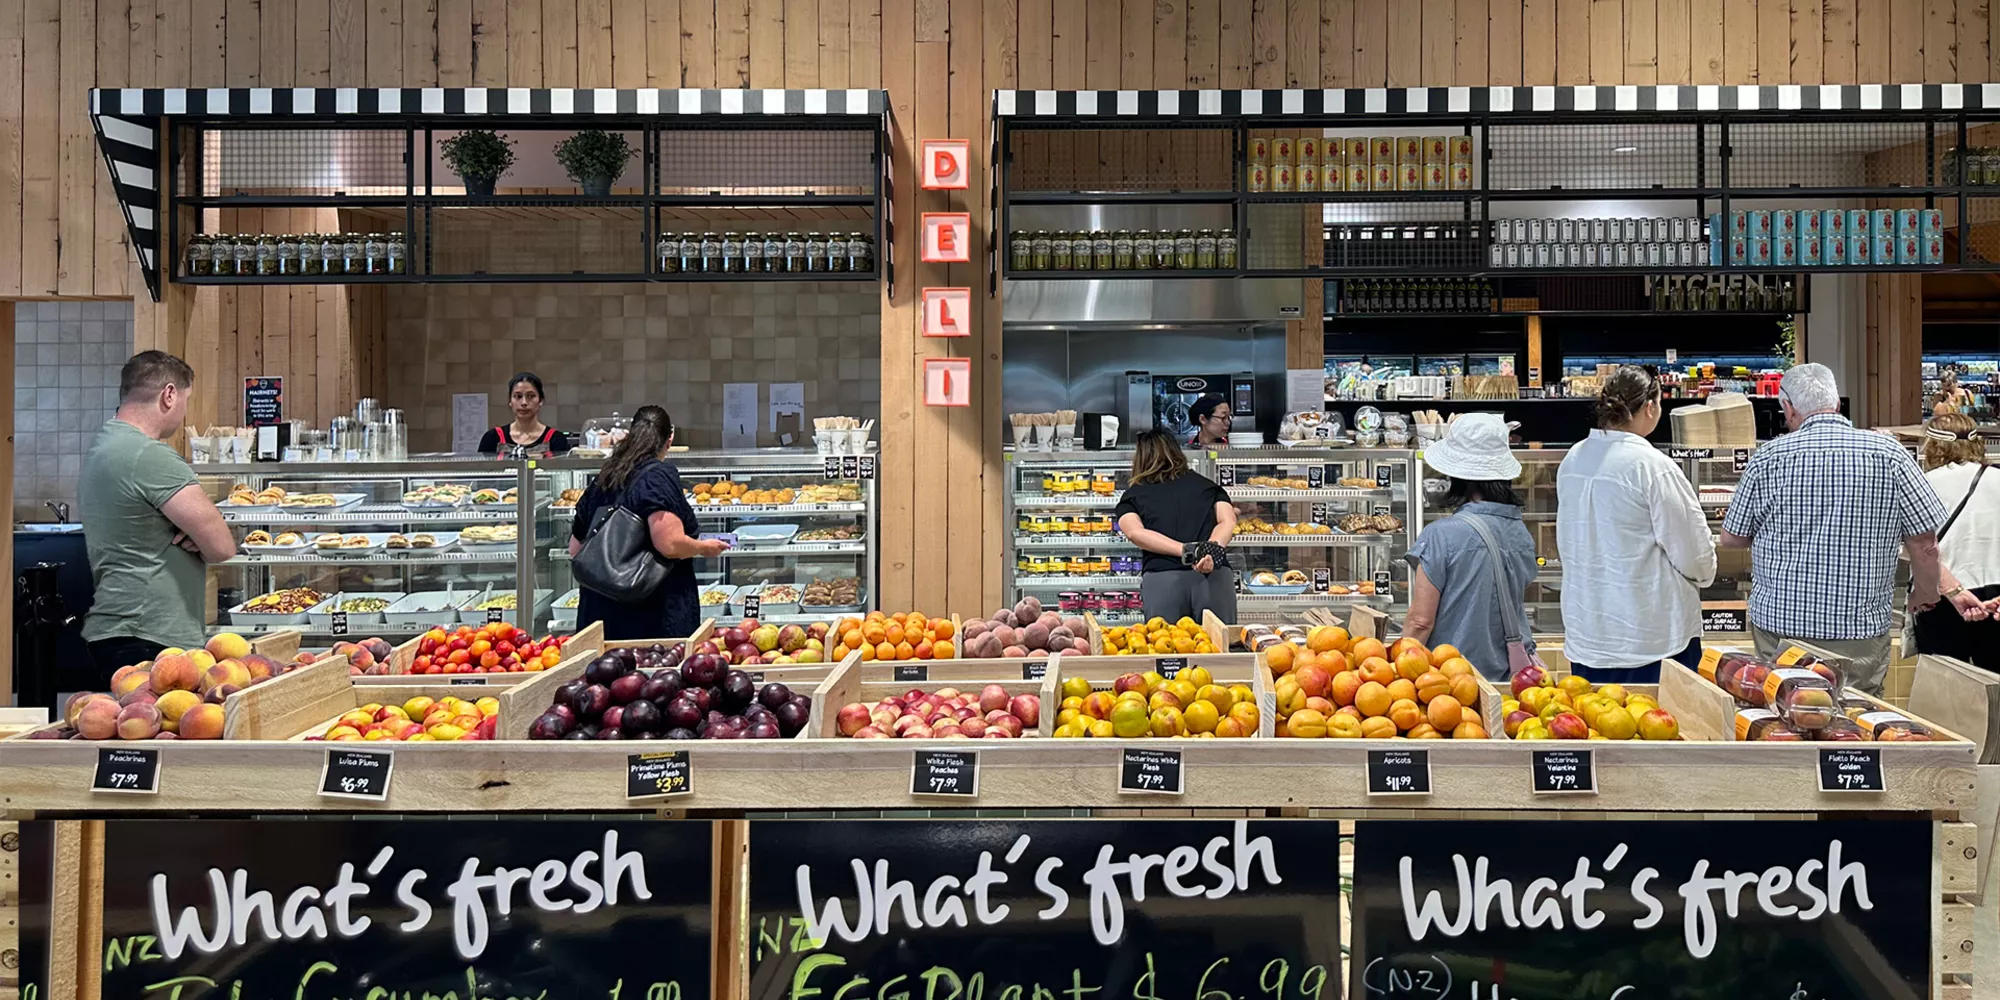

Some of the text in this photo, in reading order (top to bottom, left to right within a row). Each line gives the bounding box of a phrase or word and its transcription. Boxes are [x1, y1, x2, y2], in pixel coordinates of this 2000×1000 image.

[935, 151, 957, 396] DELI
[1644, 274, 1764, 297] KITCHEN
[109, 754, 147, 763] Peachrines
[339, 757, 379, 767] Luisa Plums
[946, 758, 965, 766] Flesh
[1125, 754, 1178, 765] Nectarines White
[1383, 756, 1412, 765] Apricots
[1544, 756, 1579, 764] Nectarines
[1828, 754, 1871, 762] Flatto Peach
[1838, 762, 1861, 770] Golden
[630, 761, 687, 773] Primetime Plums
[638, 769, 680, 780] Yellow Flesh
[930, 765, 959, 774] Peaches
[1142, 763, 1160, 771] Flesh
[111, 772, 138, 788] $7.99
[340, 776, 369, 792] $6.99
[656, 776, 685, 793] $3.99
[929, 777, 957, 793] $7.99
[1137, 773, 1164, 789] $7.99
[1385, 775, 1412, 791] $11.99
[1549, 774, 1576, 790] $7.99
[1837, 773, 1865, 789] $7.99
[796, 820, 1283, 949] What's fresh
[152, 828, 653, 960] What's fresh
[1399, 838, 1874, 959] What's fresh
[757, 916, 823, 962] NZ
[105, 935, 162, 971] NZ
